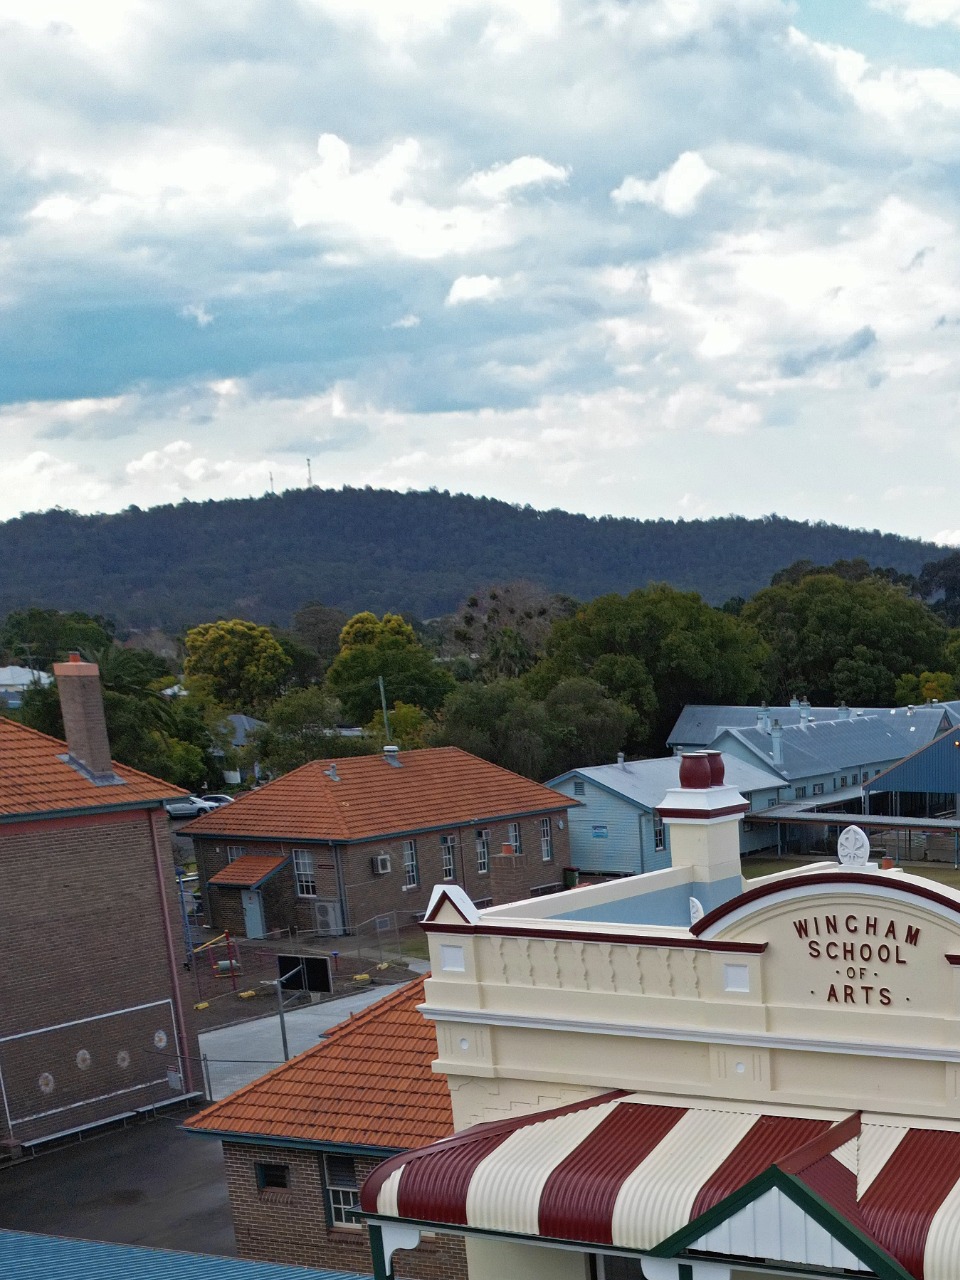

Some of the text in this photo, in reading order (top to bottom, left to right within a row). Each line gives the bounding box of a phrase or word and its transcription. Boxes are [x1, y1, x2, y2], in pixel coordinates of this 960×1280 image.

[793, 915, 921, 947] WINGHAM
[808, 940, 907, 964] SCHOOL
[846, 966, 867, 980] OF
[827, 984, 892, 1006] ARTS
